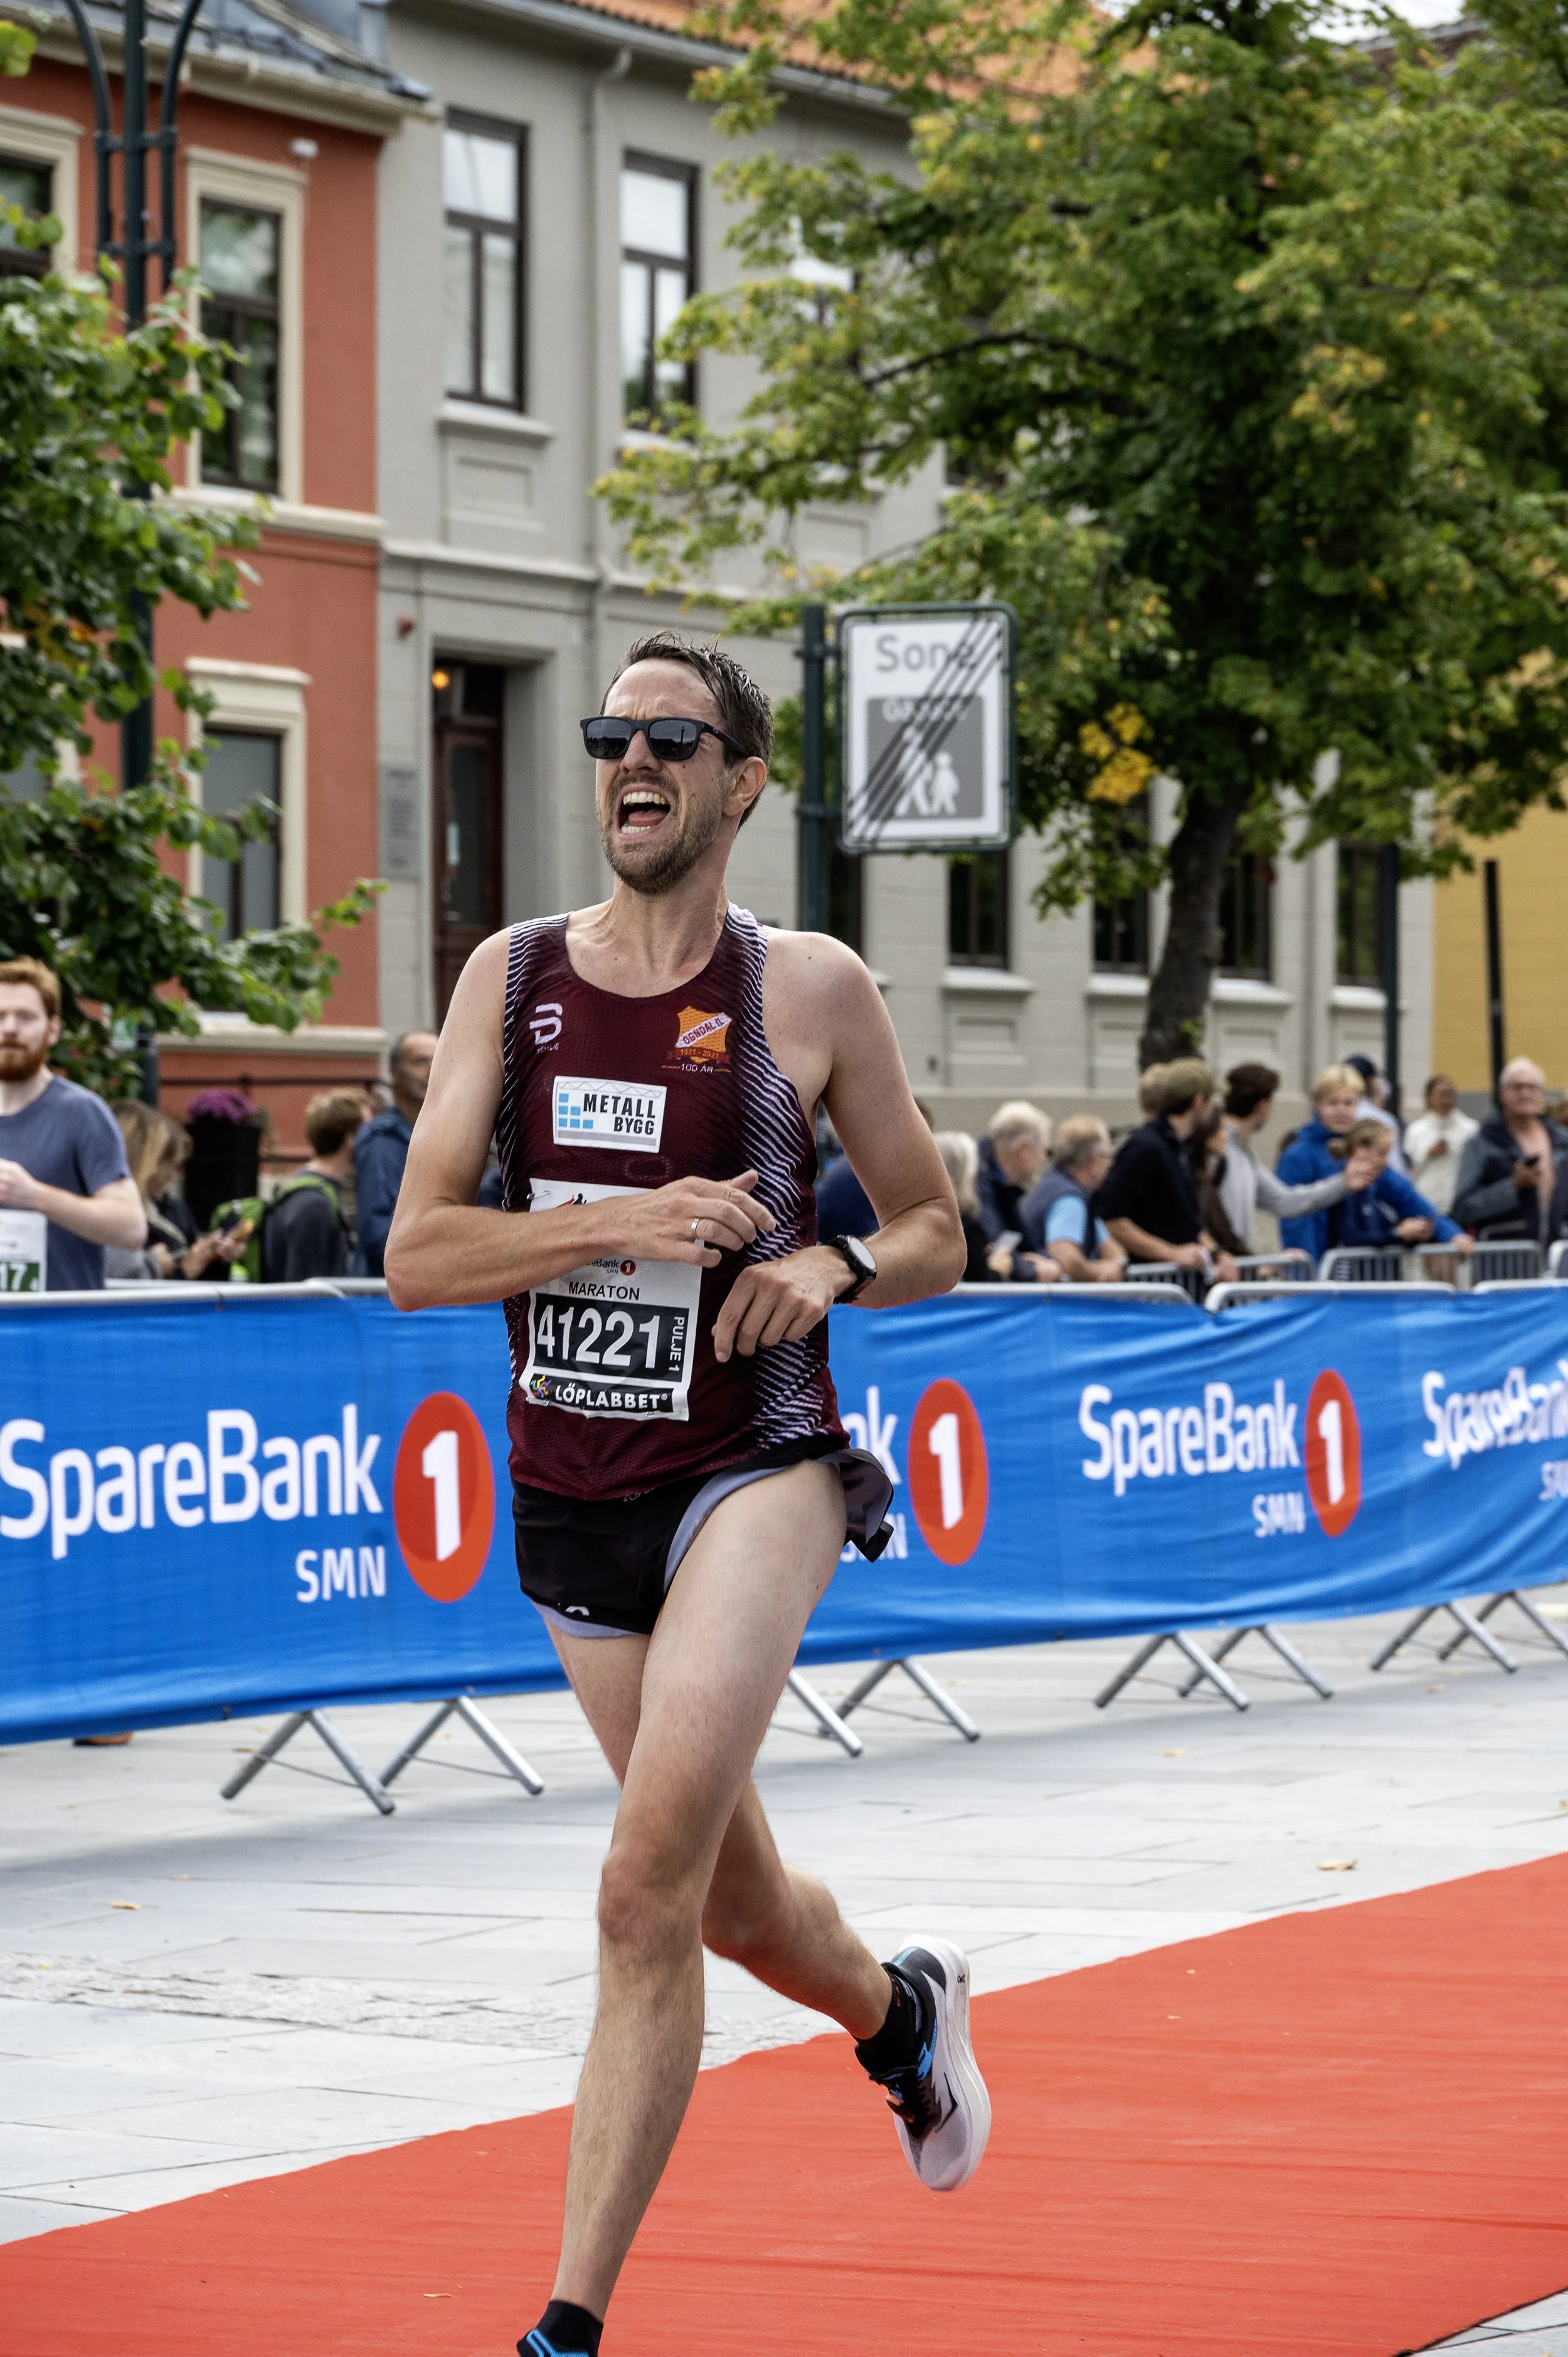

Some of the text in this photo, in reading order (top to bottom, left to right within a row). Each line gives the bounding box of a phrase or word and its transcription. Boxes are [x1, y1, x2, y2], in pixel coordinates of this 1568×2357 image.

[683, 1022, 715, 1044] OGNDAL
[681, 1063, 697, 1072] 100
[583, 1093, 655, 1119] METALL
[613, 1117, 655, 1135] BYGG
[569, 1282, 640, 1301] MARATON
[537, 1304, 660, 1369] 41221
[669, 1316, 684, 1372] PULJE 1
[1078, 1378, 1345, 1506] SpareBank 1
[0, 1403, 461, 1561] SpareBank 1
[929, 1413, 963, 1530] 1
[1252, 1492, 1306, 1538] SMN
[295, 1545, 386, 1603] SMN
